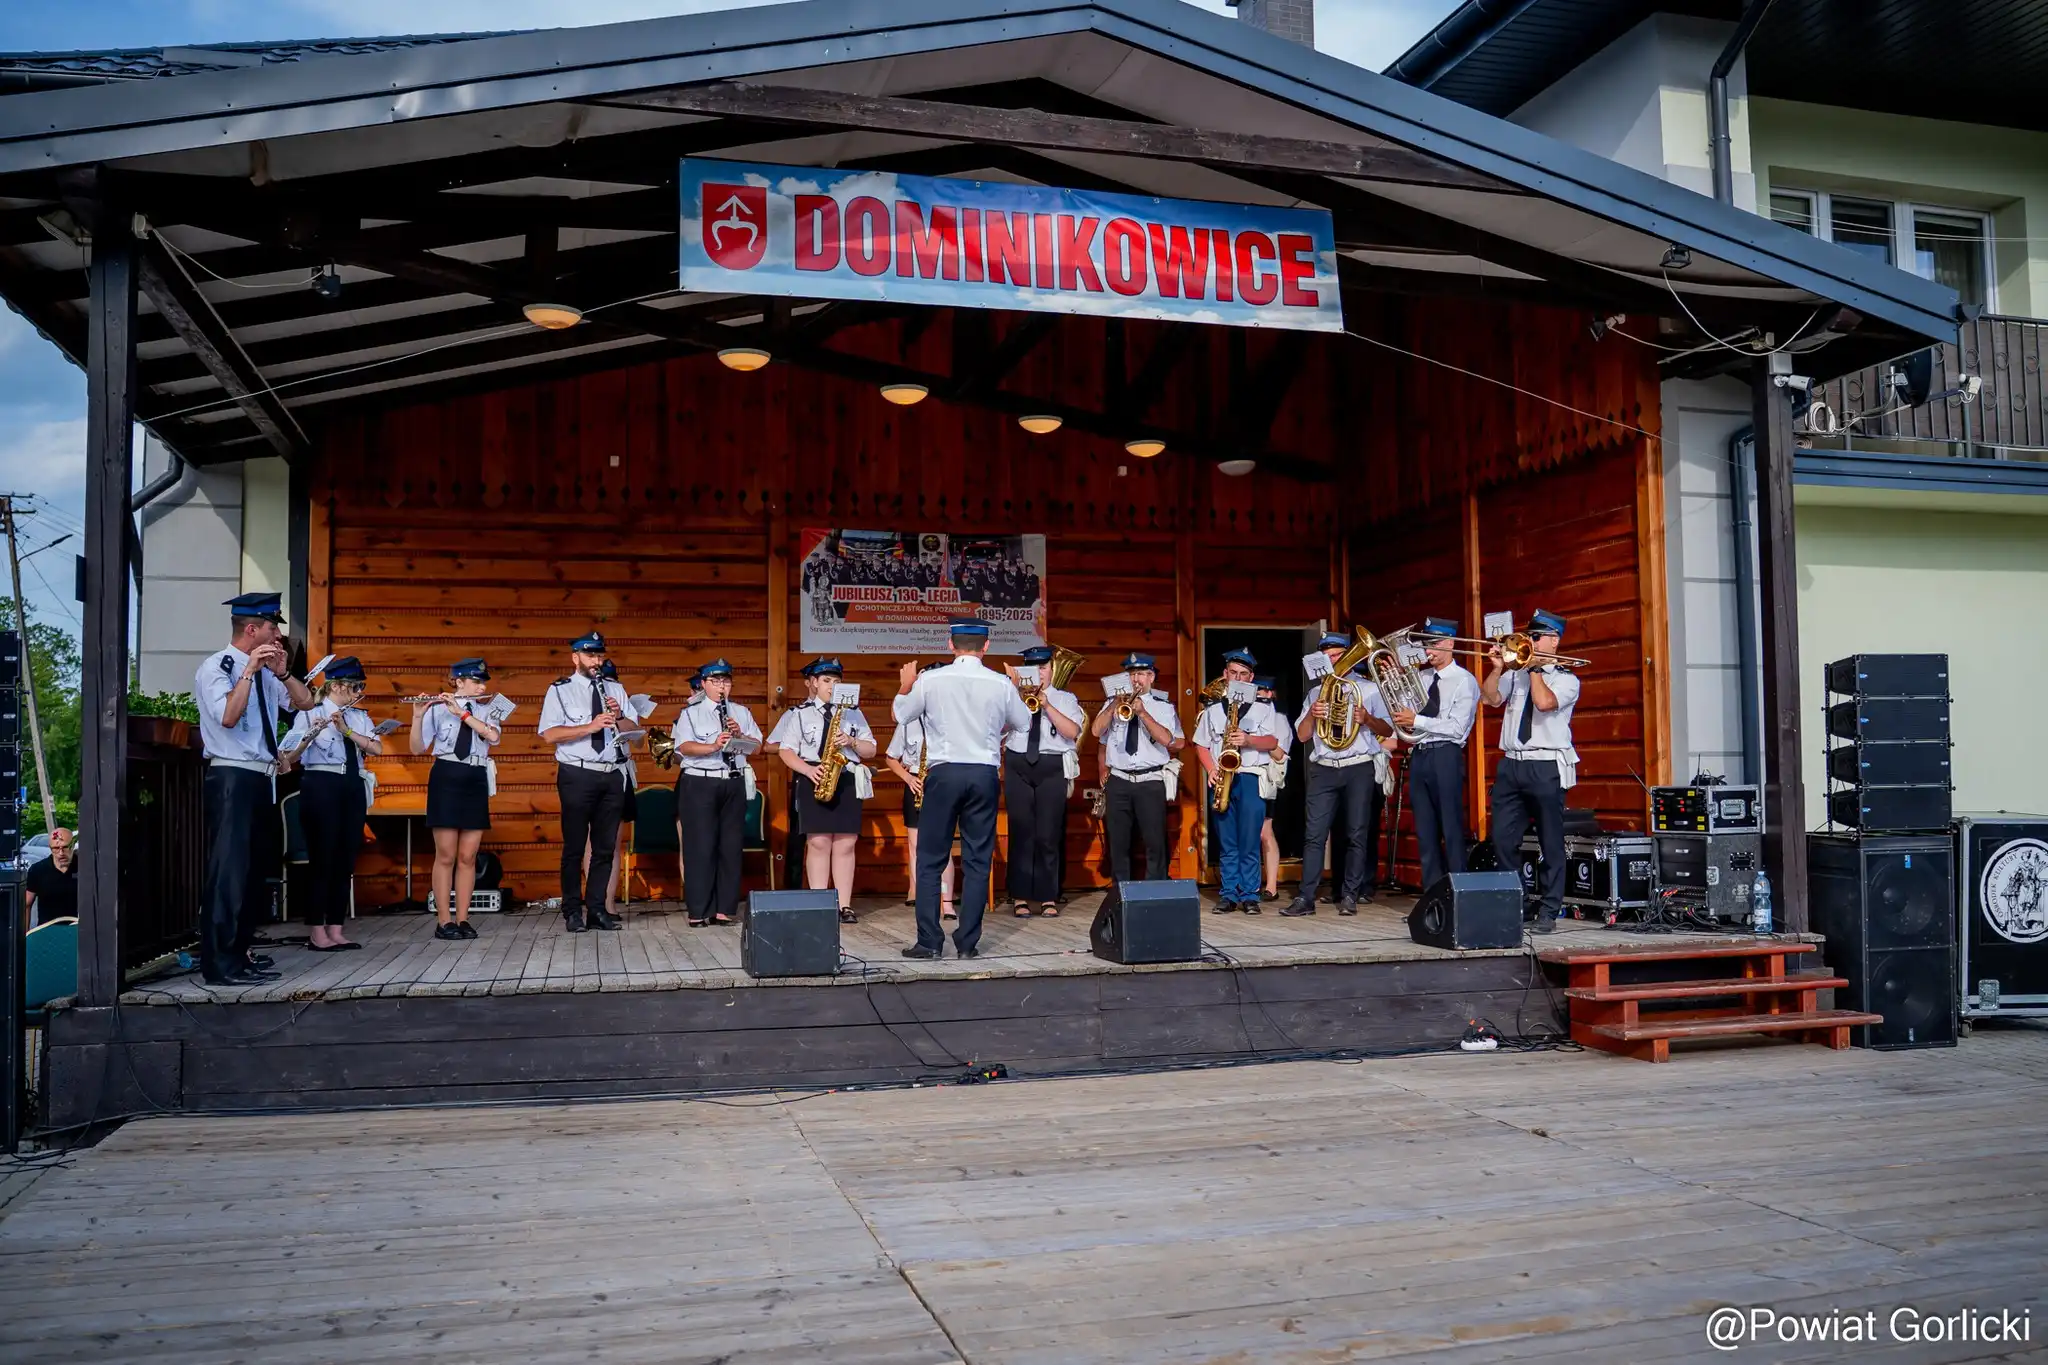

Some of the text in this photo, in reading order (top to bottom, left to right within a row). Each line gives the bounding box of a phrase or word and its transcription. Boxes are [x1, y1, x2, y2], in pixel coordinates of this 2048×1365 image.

[794, 193, 1320, 307] DOMINIKOWICE
[832, 586, 893, 602] JUBILEUSZ
[927, 589, 960, 603] LECIA
[854, 604, 906, 613] OCHOTNICZEJ
[876, 614, 949, 623] W DOMINIKOWICAC
